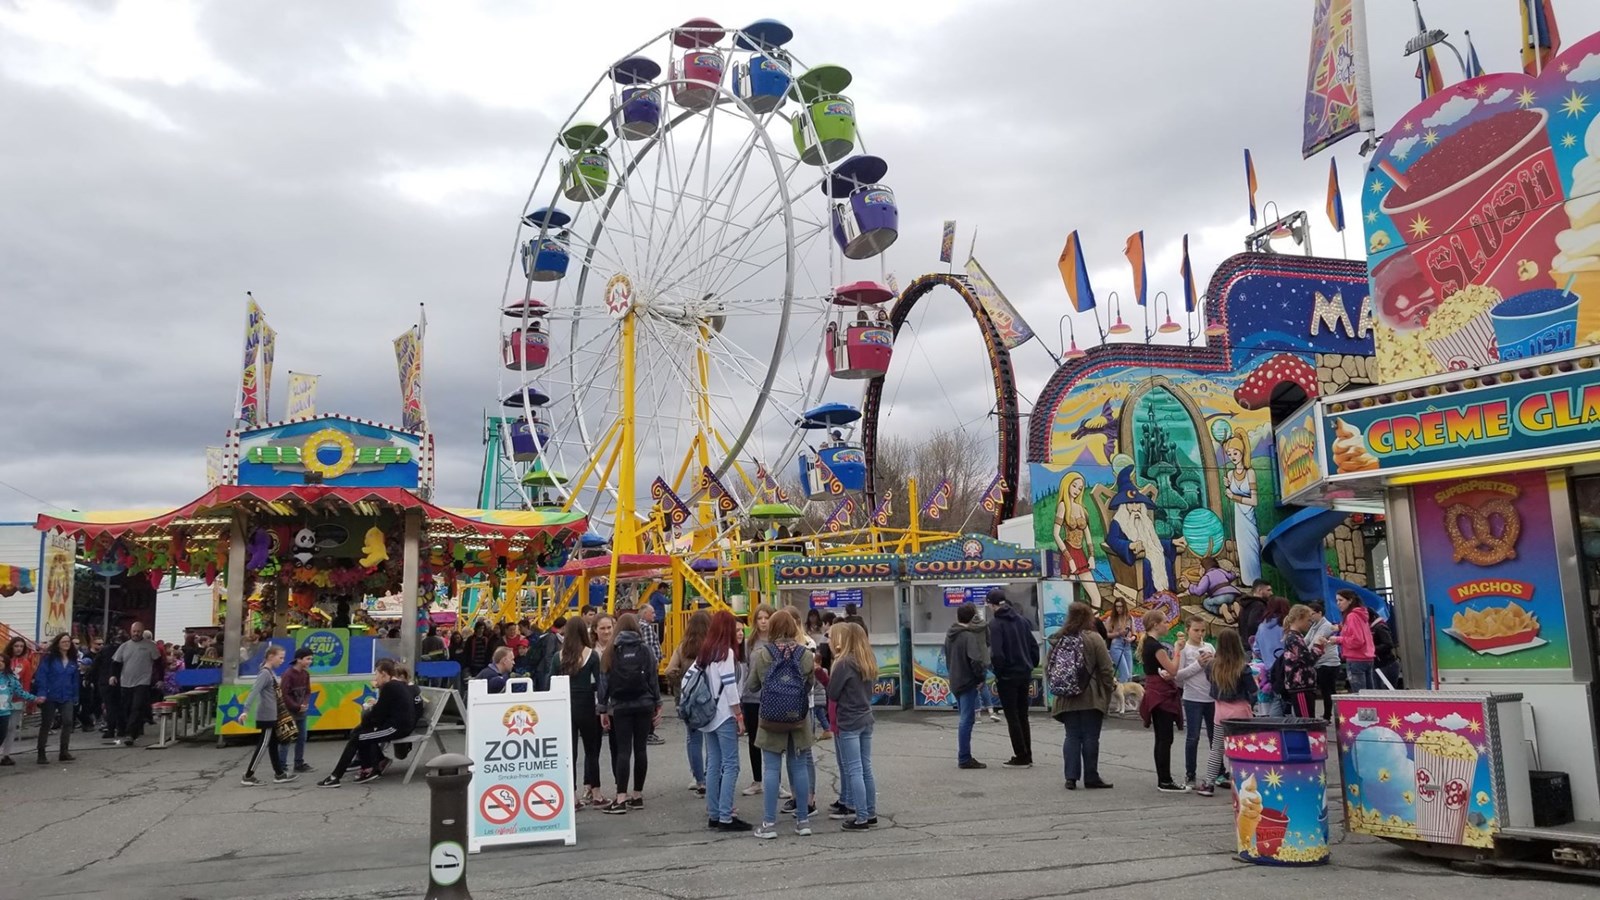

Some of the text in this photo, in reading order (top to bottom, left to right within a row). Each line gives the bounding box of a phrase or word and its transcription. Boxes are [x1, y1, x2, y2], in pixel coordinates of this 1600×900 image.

[1427, 161, 1555, 299] SLUSH
[1367, 385, 1600, 453] CRÈME GLA
[1434, 480, 1518, 503] SUPERPRETZEL
[781, 563, 891, 577] COUPONS
[914, 558, 1034, 573] COUPONS
[1457, 582, 1523, 597] NACHOS
[309, 642, 335, 653] EAU
[484, 737, 558, 761] ZONE
[484, 758, 558, 774] SANS FUMÉE
[1446, 781, 1463, 796] POP
[1447, 790, 1467, 806] CORN
